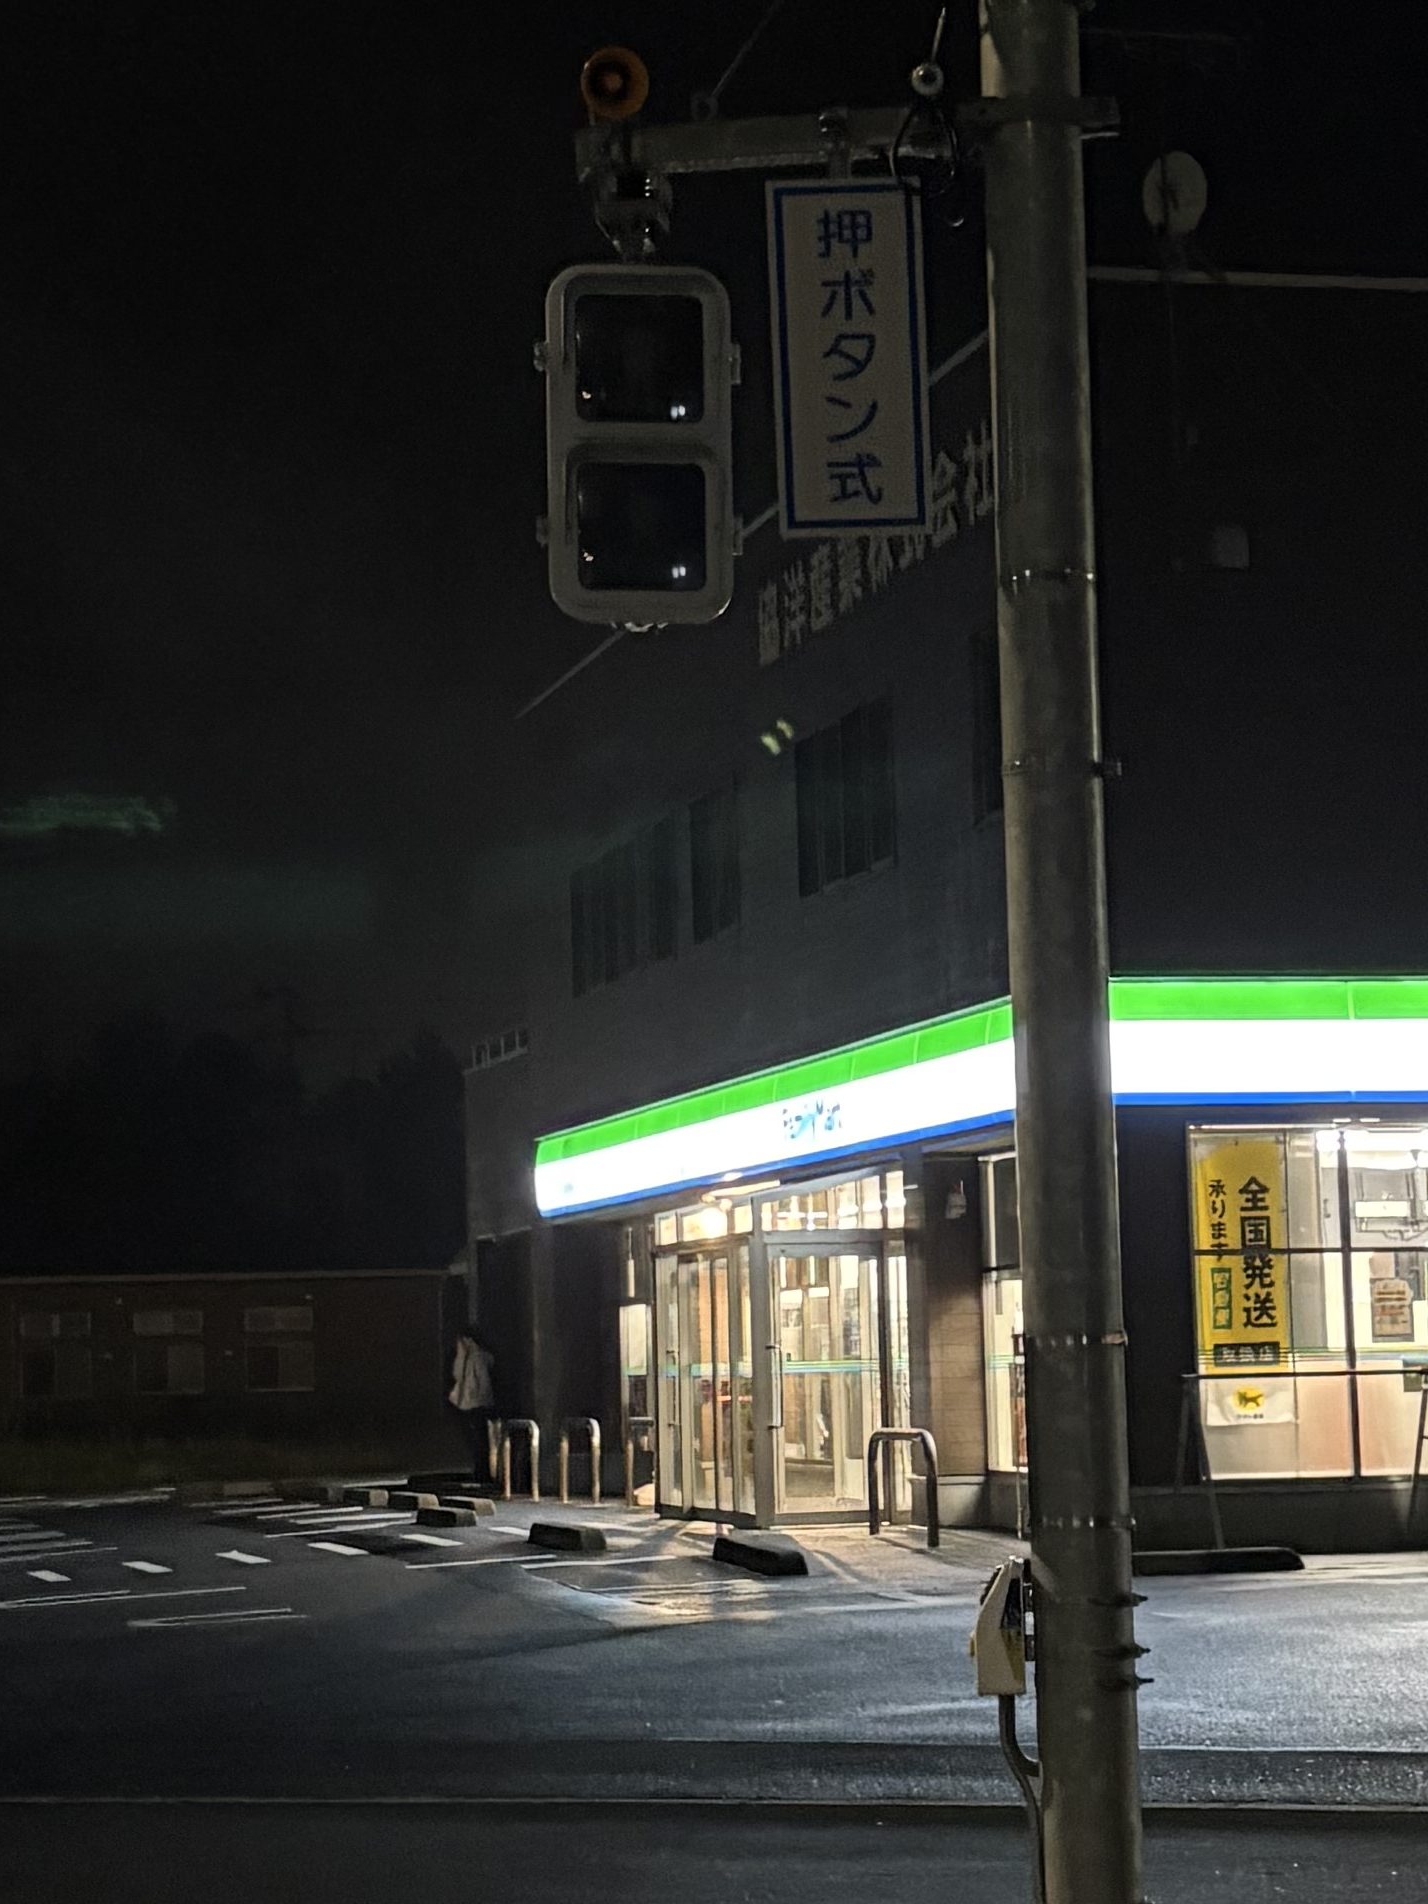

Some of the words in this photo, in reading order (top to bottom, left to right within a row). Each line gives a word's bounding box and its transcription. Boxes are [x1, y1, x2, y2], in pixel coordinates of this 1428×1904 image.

[817, 208, 883, 505] 押ボタン式
[1239, 1176, 1277, 1329] 全国発送
